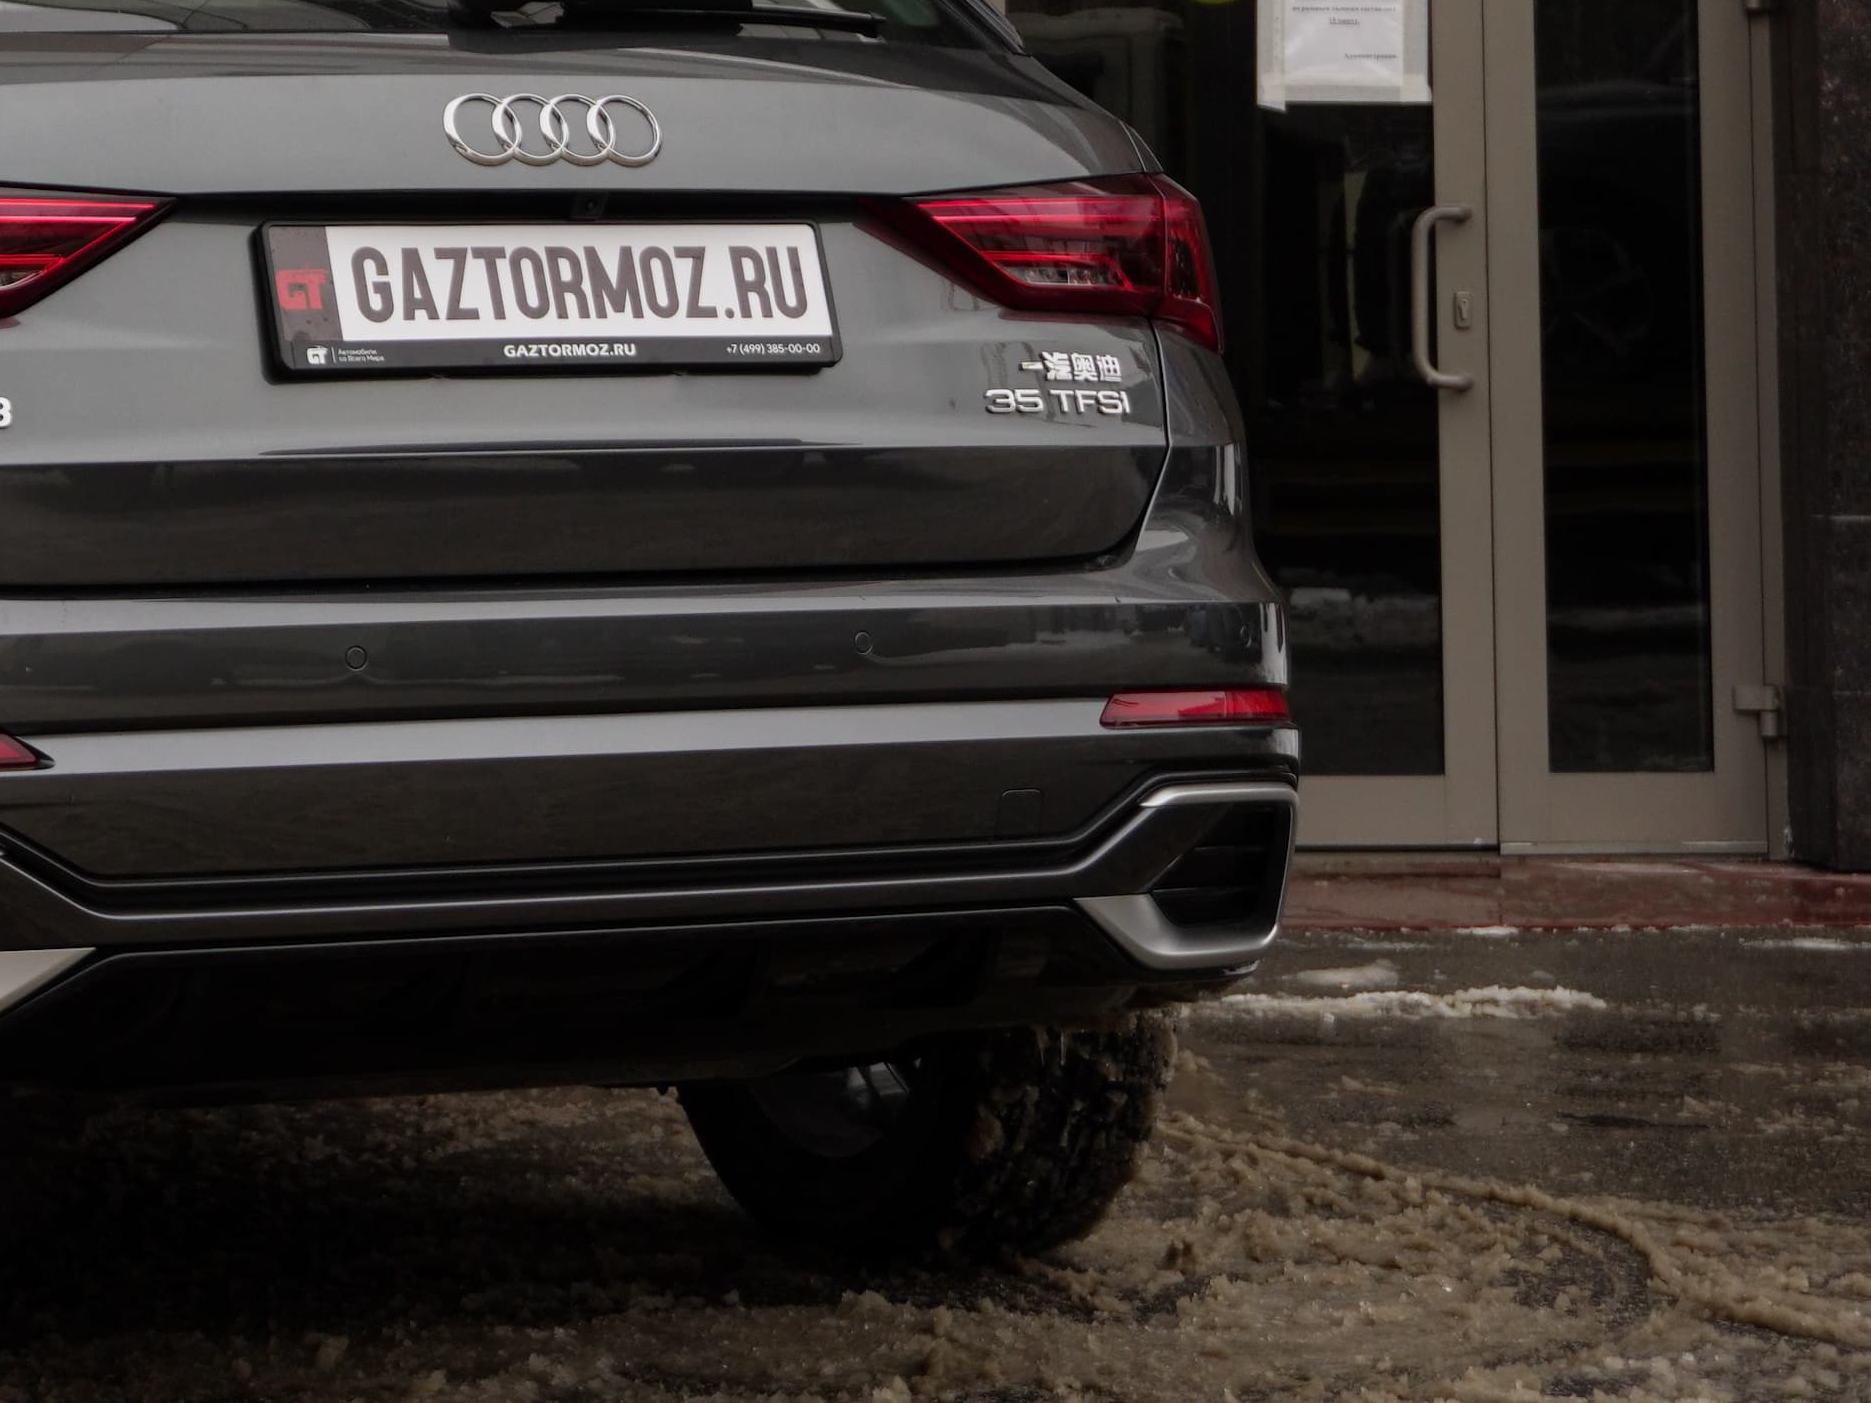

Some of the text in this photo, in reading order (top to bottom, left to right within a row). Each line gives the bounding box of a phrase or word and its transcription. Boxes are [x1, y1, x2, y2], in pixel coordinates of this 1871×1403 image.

[349, 245, 809, 324] GAZTORMOZ.RU
[503, 343, 637, 358] GAZTORMOZ.RU
[726, 343, 821, 355] +7 (499) 385-00-00
[984, 388, 1131, 415] 35 TFSI
